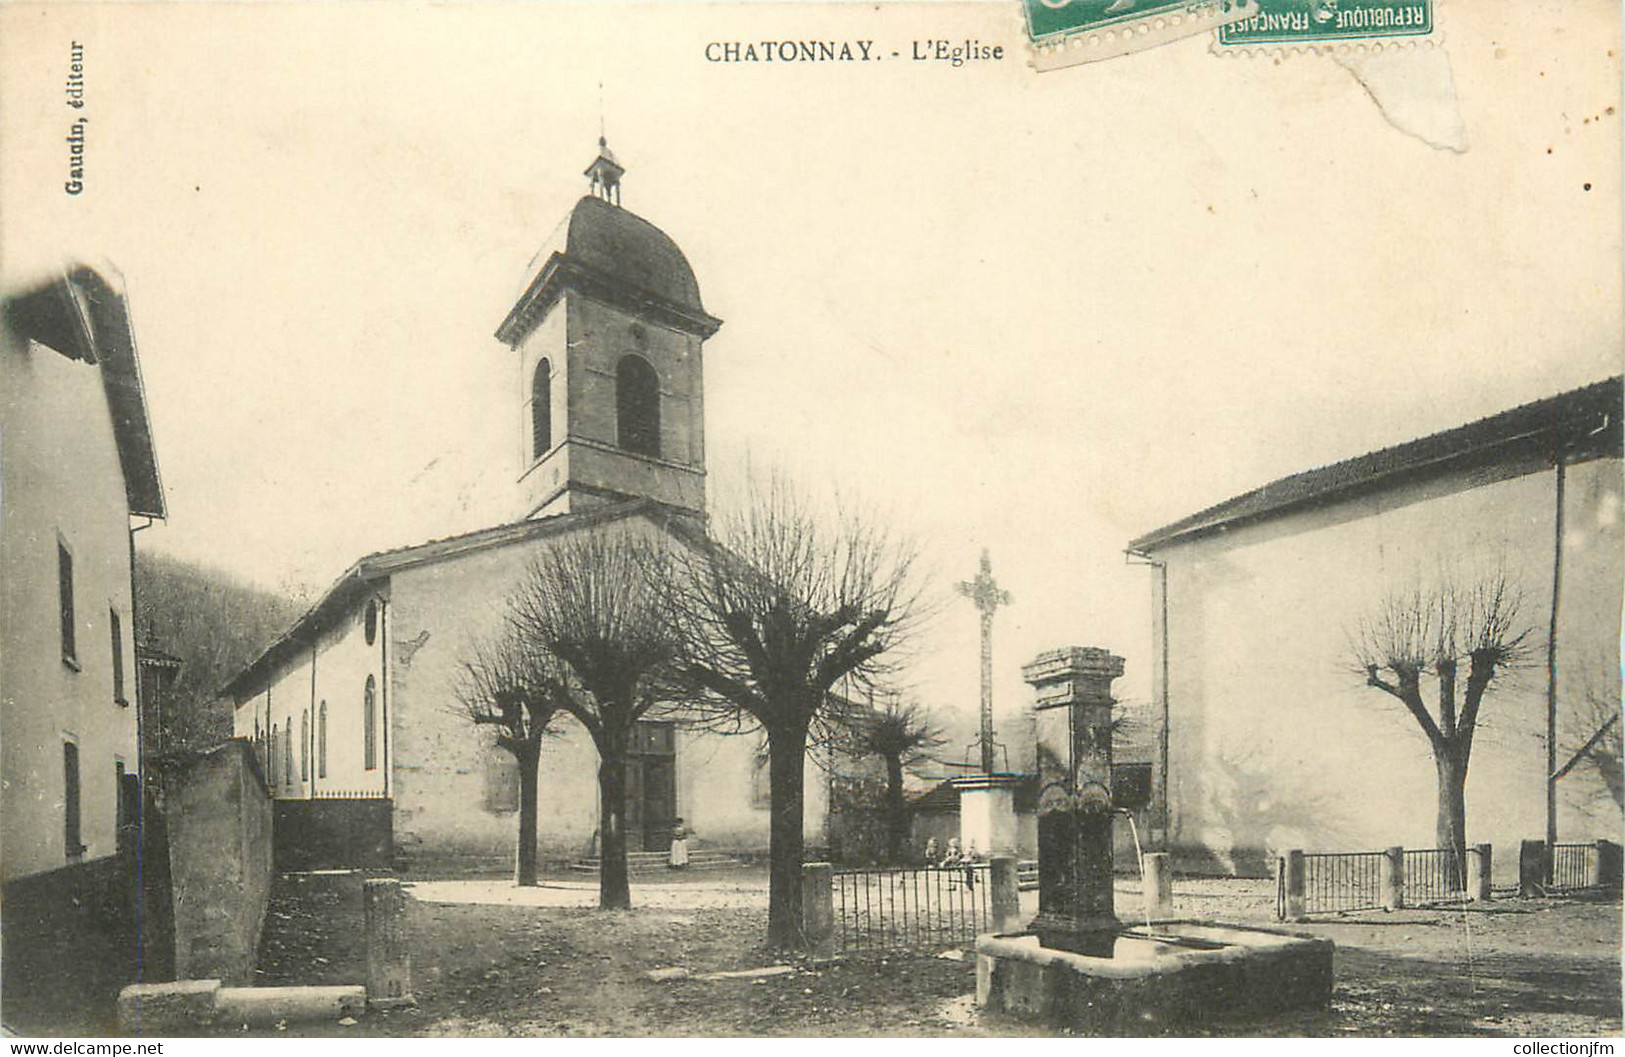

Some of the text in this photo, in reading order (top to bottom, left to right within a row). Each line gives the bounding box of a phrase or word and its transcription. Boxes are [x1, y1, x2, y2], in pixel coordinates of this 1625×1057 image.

[1335, 6, 1424, 28] REPUBLIQUE
[705, 40, 882, 62] CHATONNAY.
[912, 40, 1004, 67] L'Eglise
[66, 41, 84, 109] éditeur
